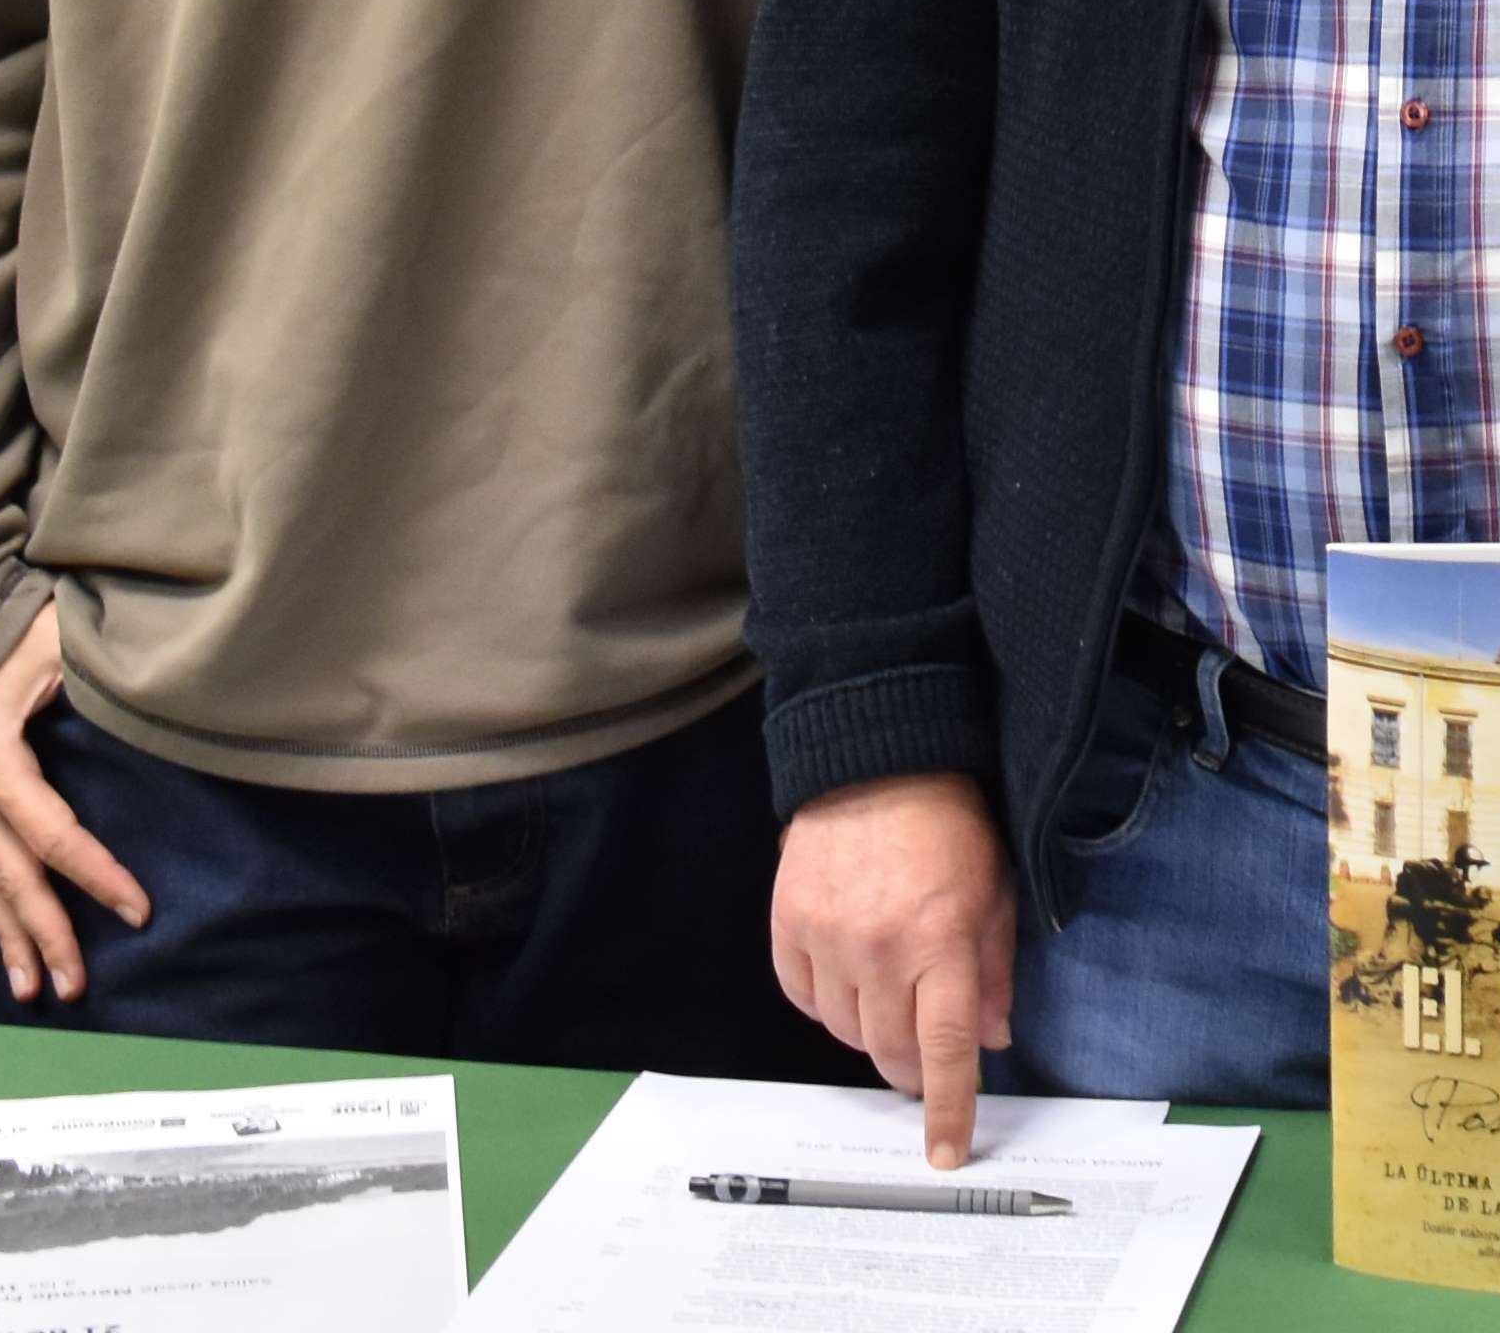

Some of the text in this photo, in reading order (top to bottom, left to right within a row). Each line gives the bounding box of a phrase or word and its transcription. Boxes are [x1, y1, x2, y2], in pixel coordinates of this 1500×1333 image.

[1402, 964, 1482, 1057] EL
[1384, 1162, 1406, 1179] LA
[1417, 1164, 1492, 1191] ÚLTIMA
[1444, 1196, 1469, 1212] DE
